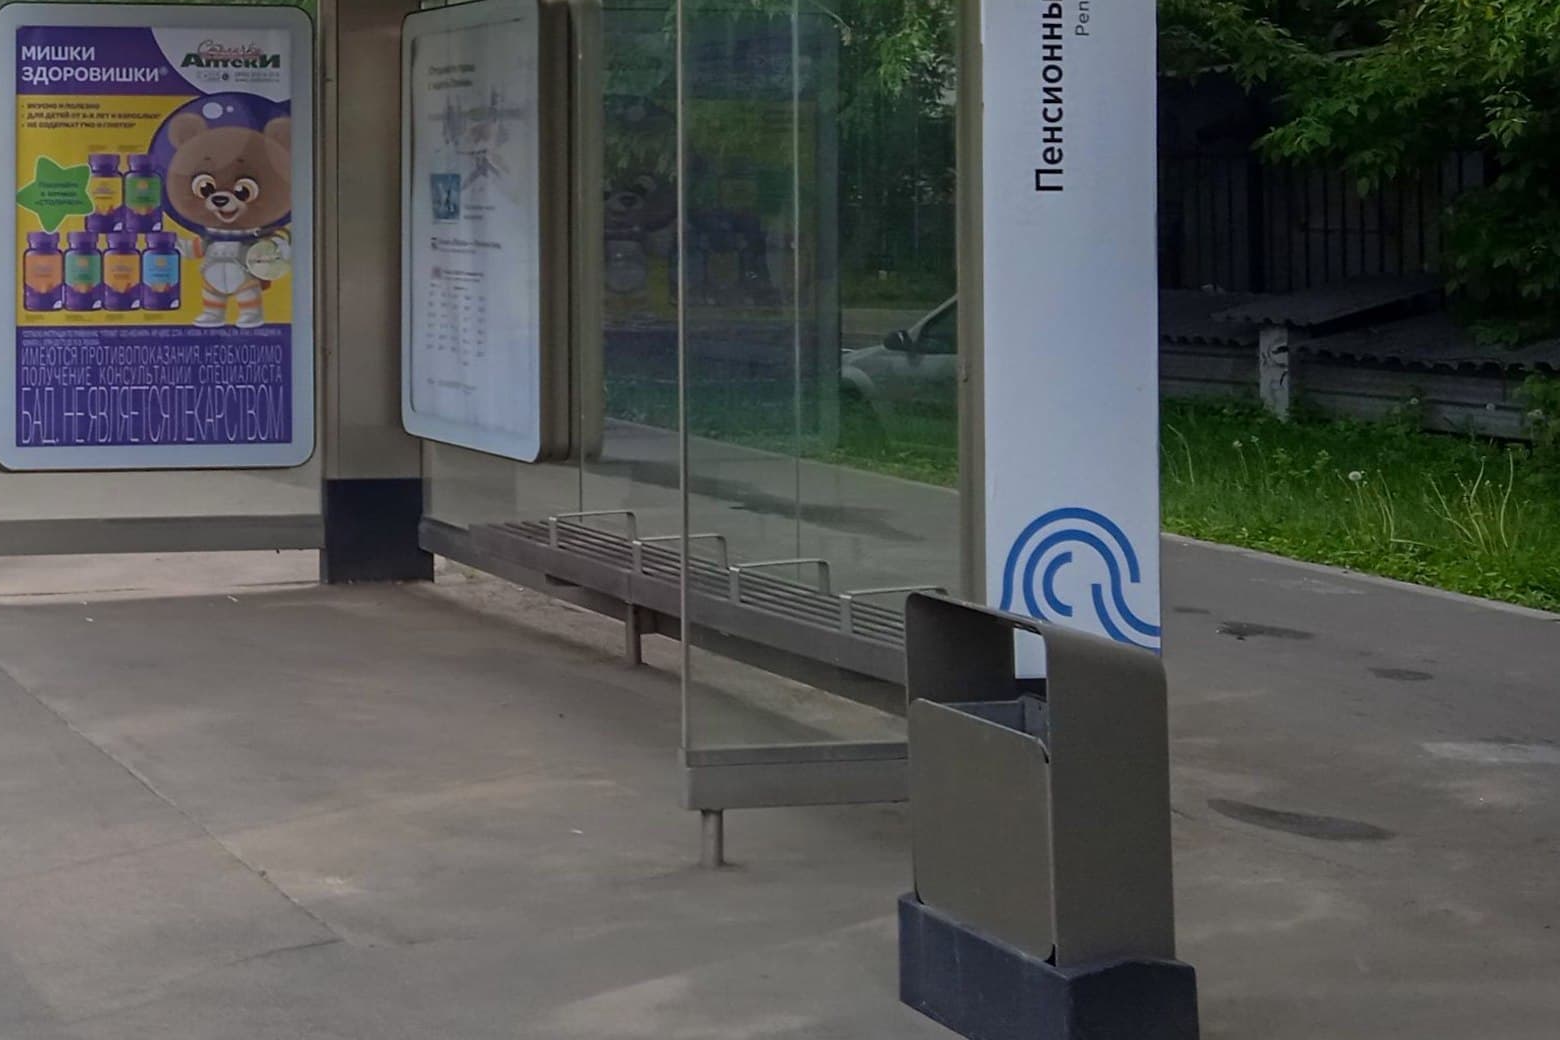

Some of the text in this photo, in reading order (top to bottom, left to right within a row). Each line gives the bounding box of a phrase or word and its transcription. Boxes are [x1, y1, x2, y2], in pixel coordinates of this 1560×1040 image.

[21, 46, 96, 61] МИШКИ
[21, 346, 78, 366] ИМЕЮТСЯ
[206, 345, 282, 364] НЕОБХОДИМО
[22, 364, 282, 386] ПОЛУЧЕНИЕ КОНСУЛЬТАЦИИ СПЕЦИАЛИСТА
[63, 387, 85, 443] НЕ
[88, 386, 170, 442] ЯВЛЯЕТСЯ
[173, 385, 283, 442] ЛЕКАРСТВОМ
